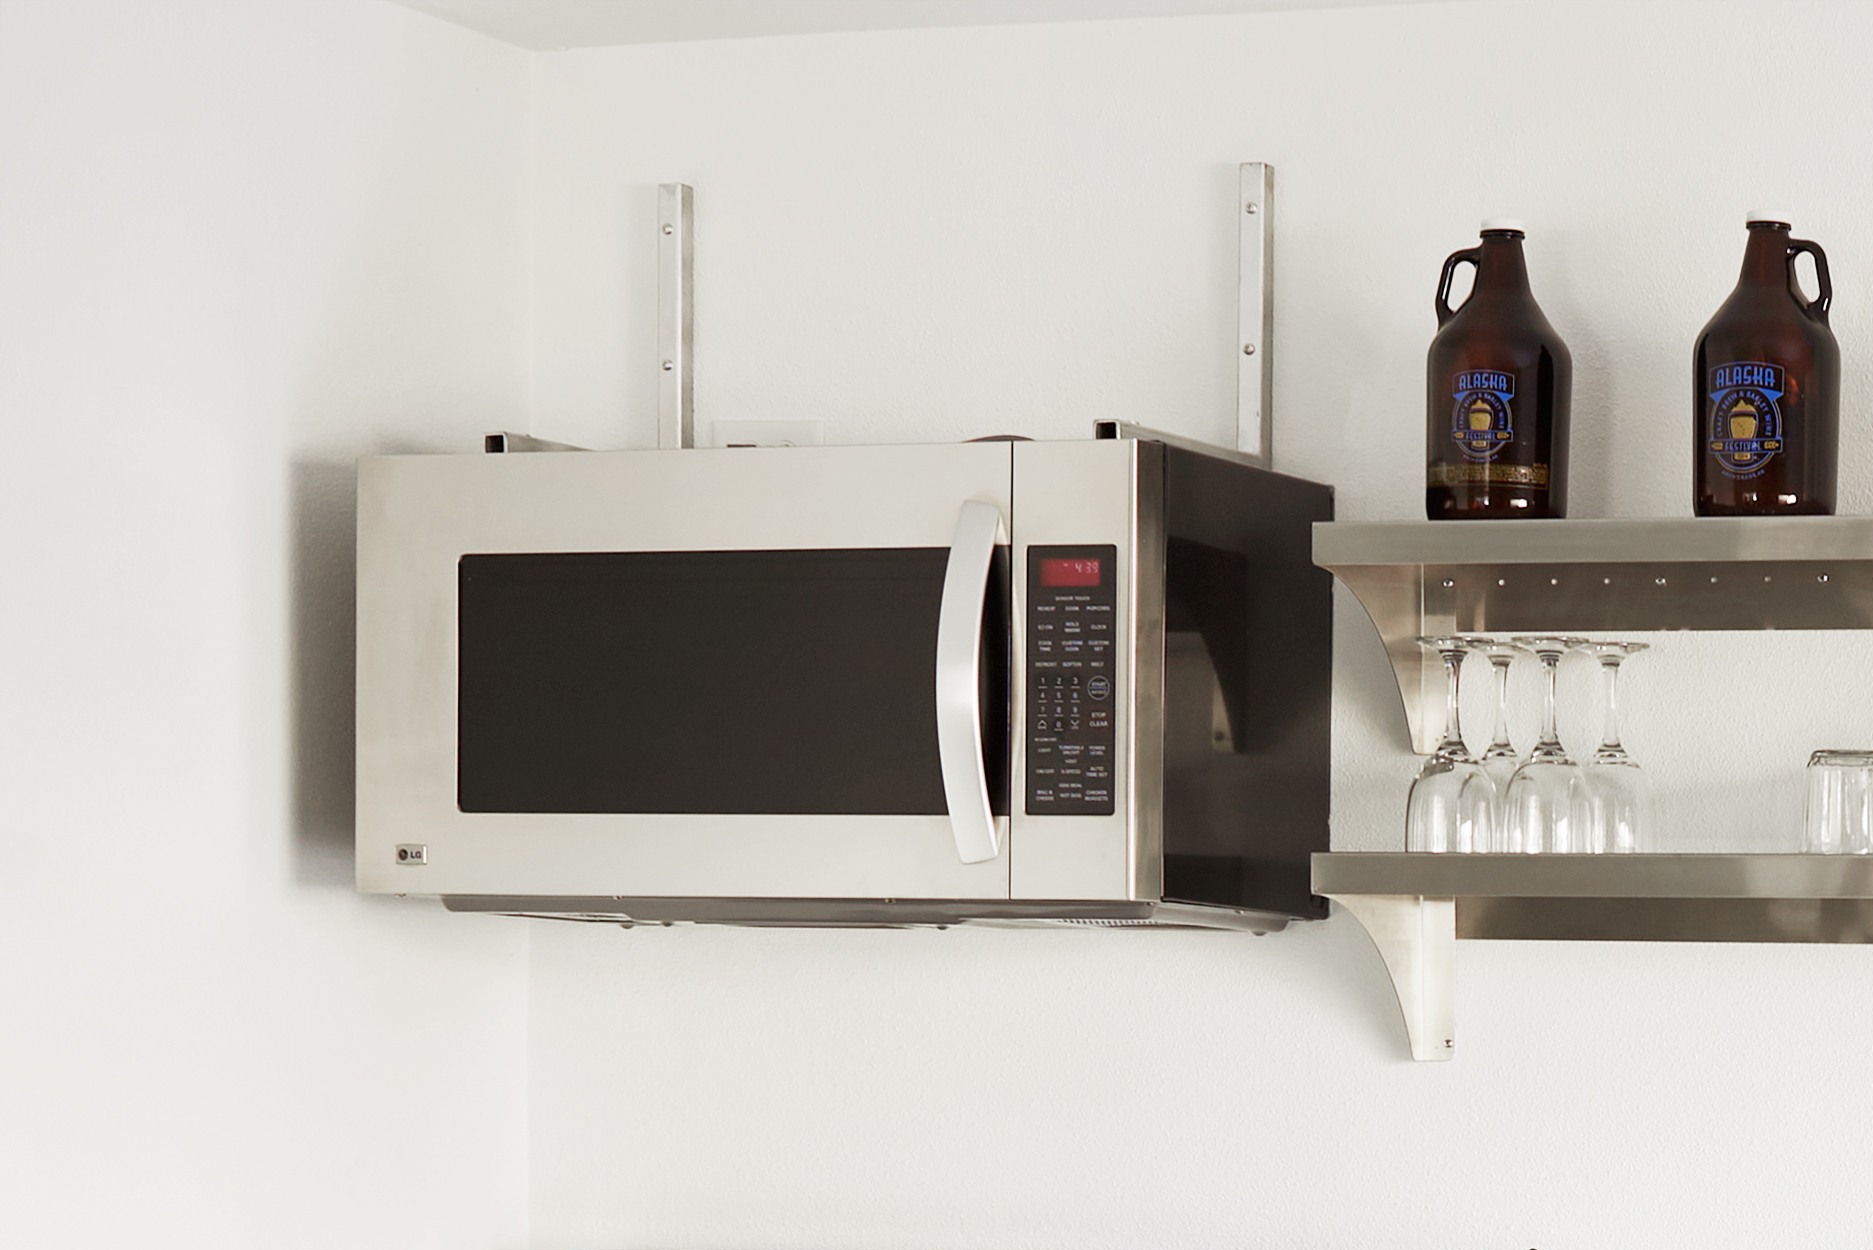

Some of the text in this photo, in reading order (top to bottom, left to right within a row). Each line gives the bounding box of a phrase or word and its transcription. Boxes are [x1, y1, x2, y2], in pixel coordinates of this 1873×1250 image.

[1458, 372, 1508, 391] ALASKA
[1716, 366, 1776, 388] ALASKA
[1725, 441, 1762, 450] FESTIVAL
